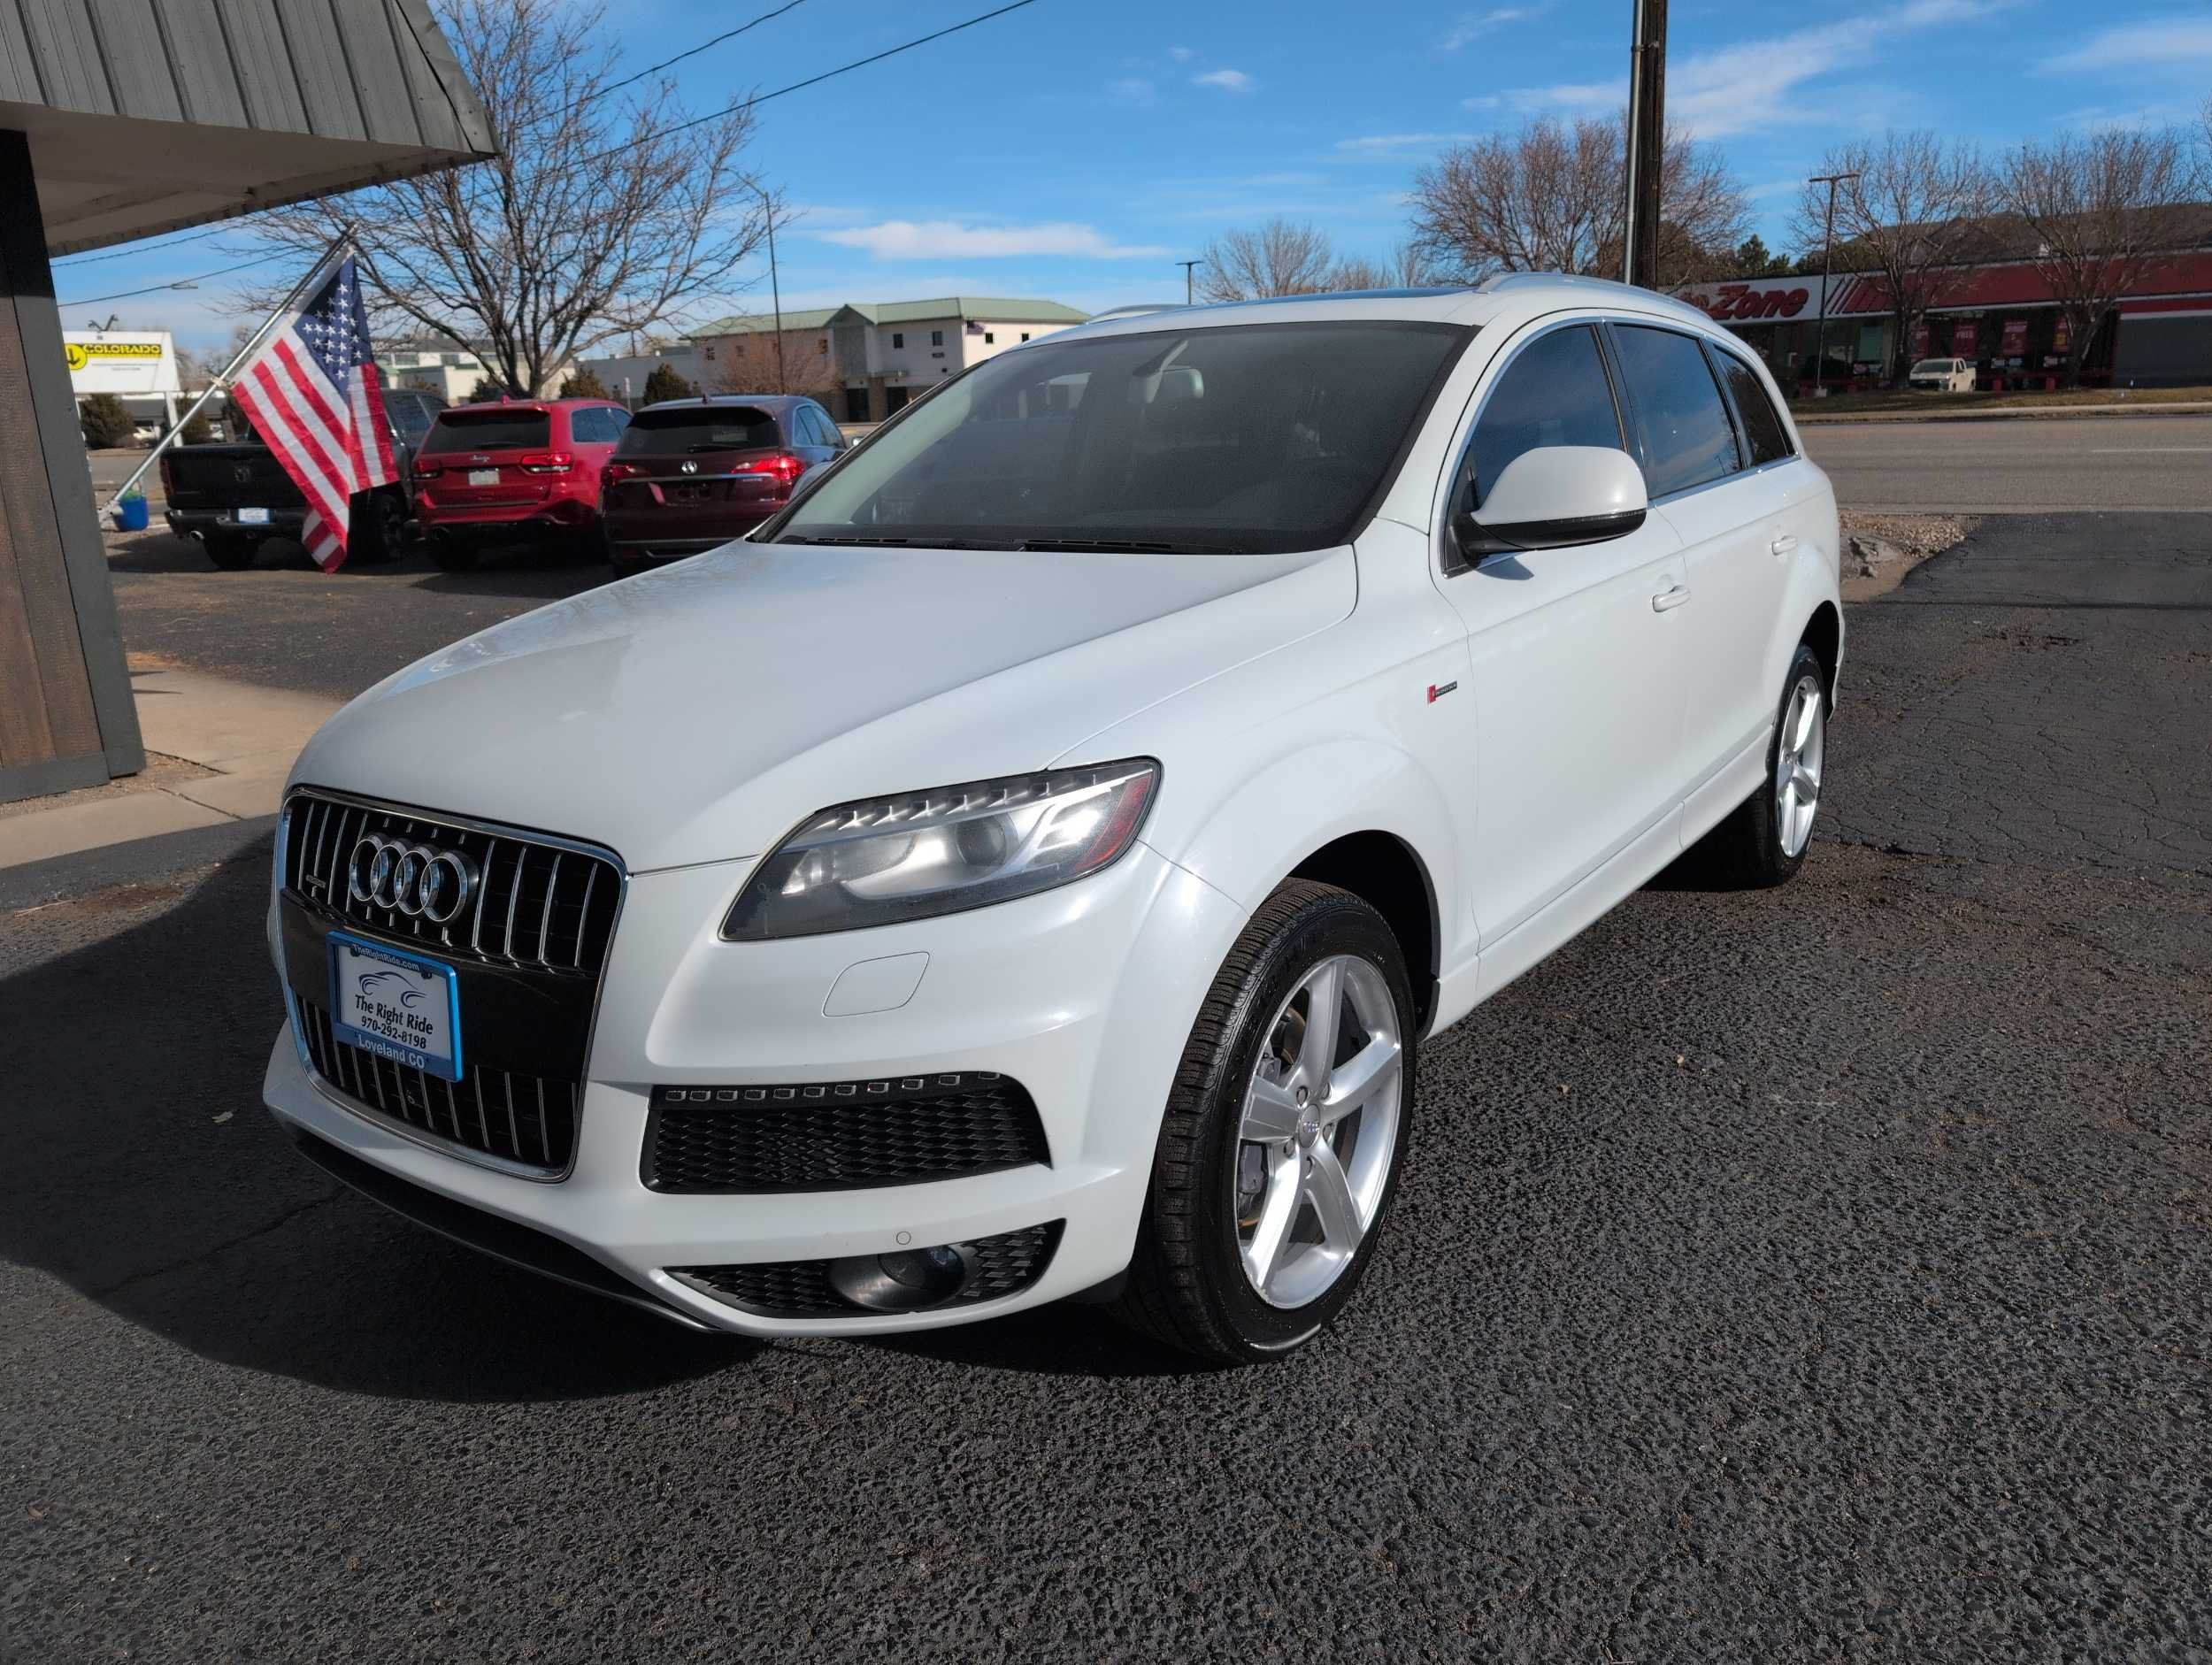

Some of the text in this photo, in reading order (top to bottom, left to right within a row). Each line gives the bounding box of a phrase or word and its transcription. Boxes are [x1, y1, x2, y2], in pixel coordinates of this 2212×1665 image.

[83, 344, 160, 354] COLORADO
[352, 943, 419, 971] TheRightRide.com
[355, 994, 434, 1035] The Right Ride
[361, 1016, 426, 1049] 970-292-8198
[357, 1033, 426, 1070] Loveland CO
